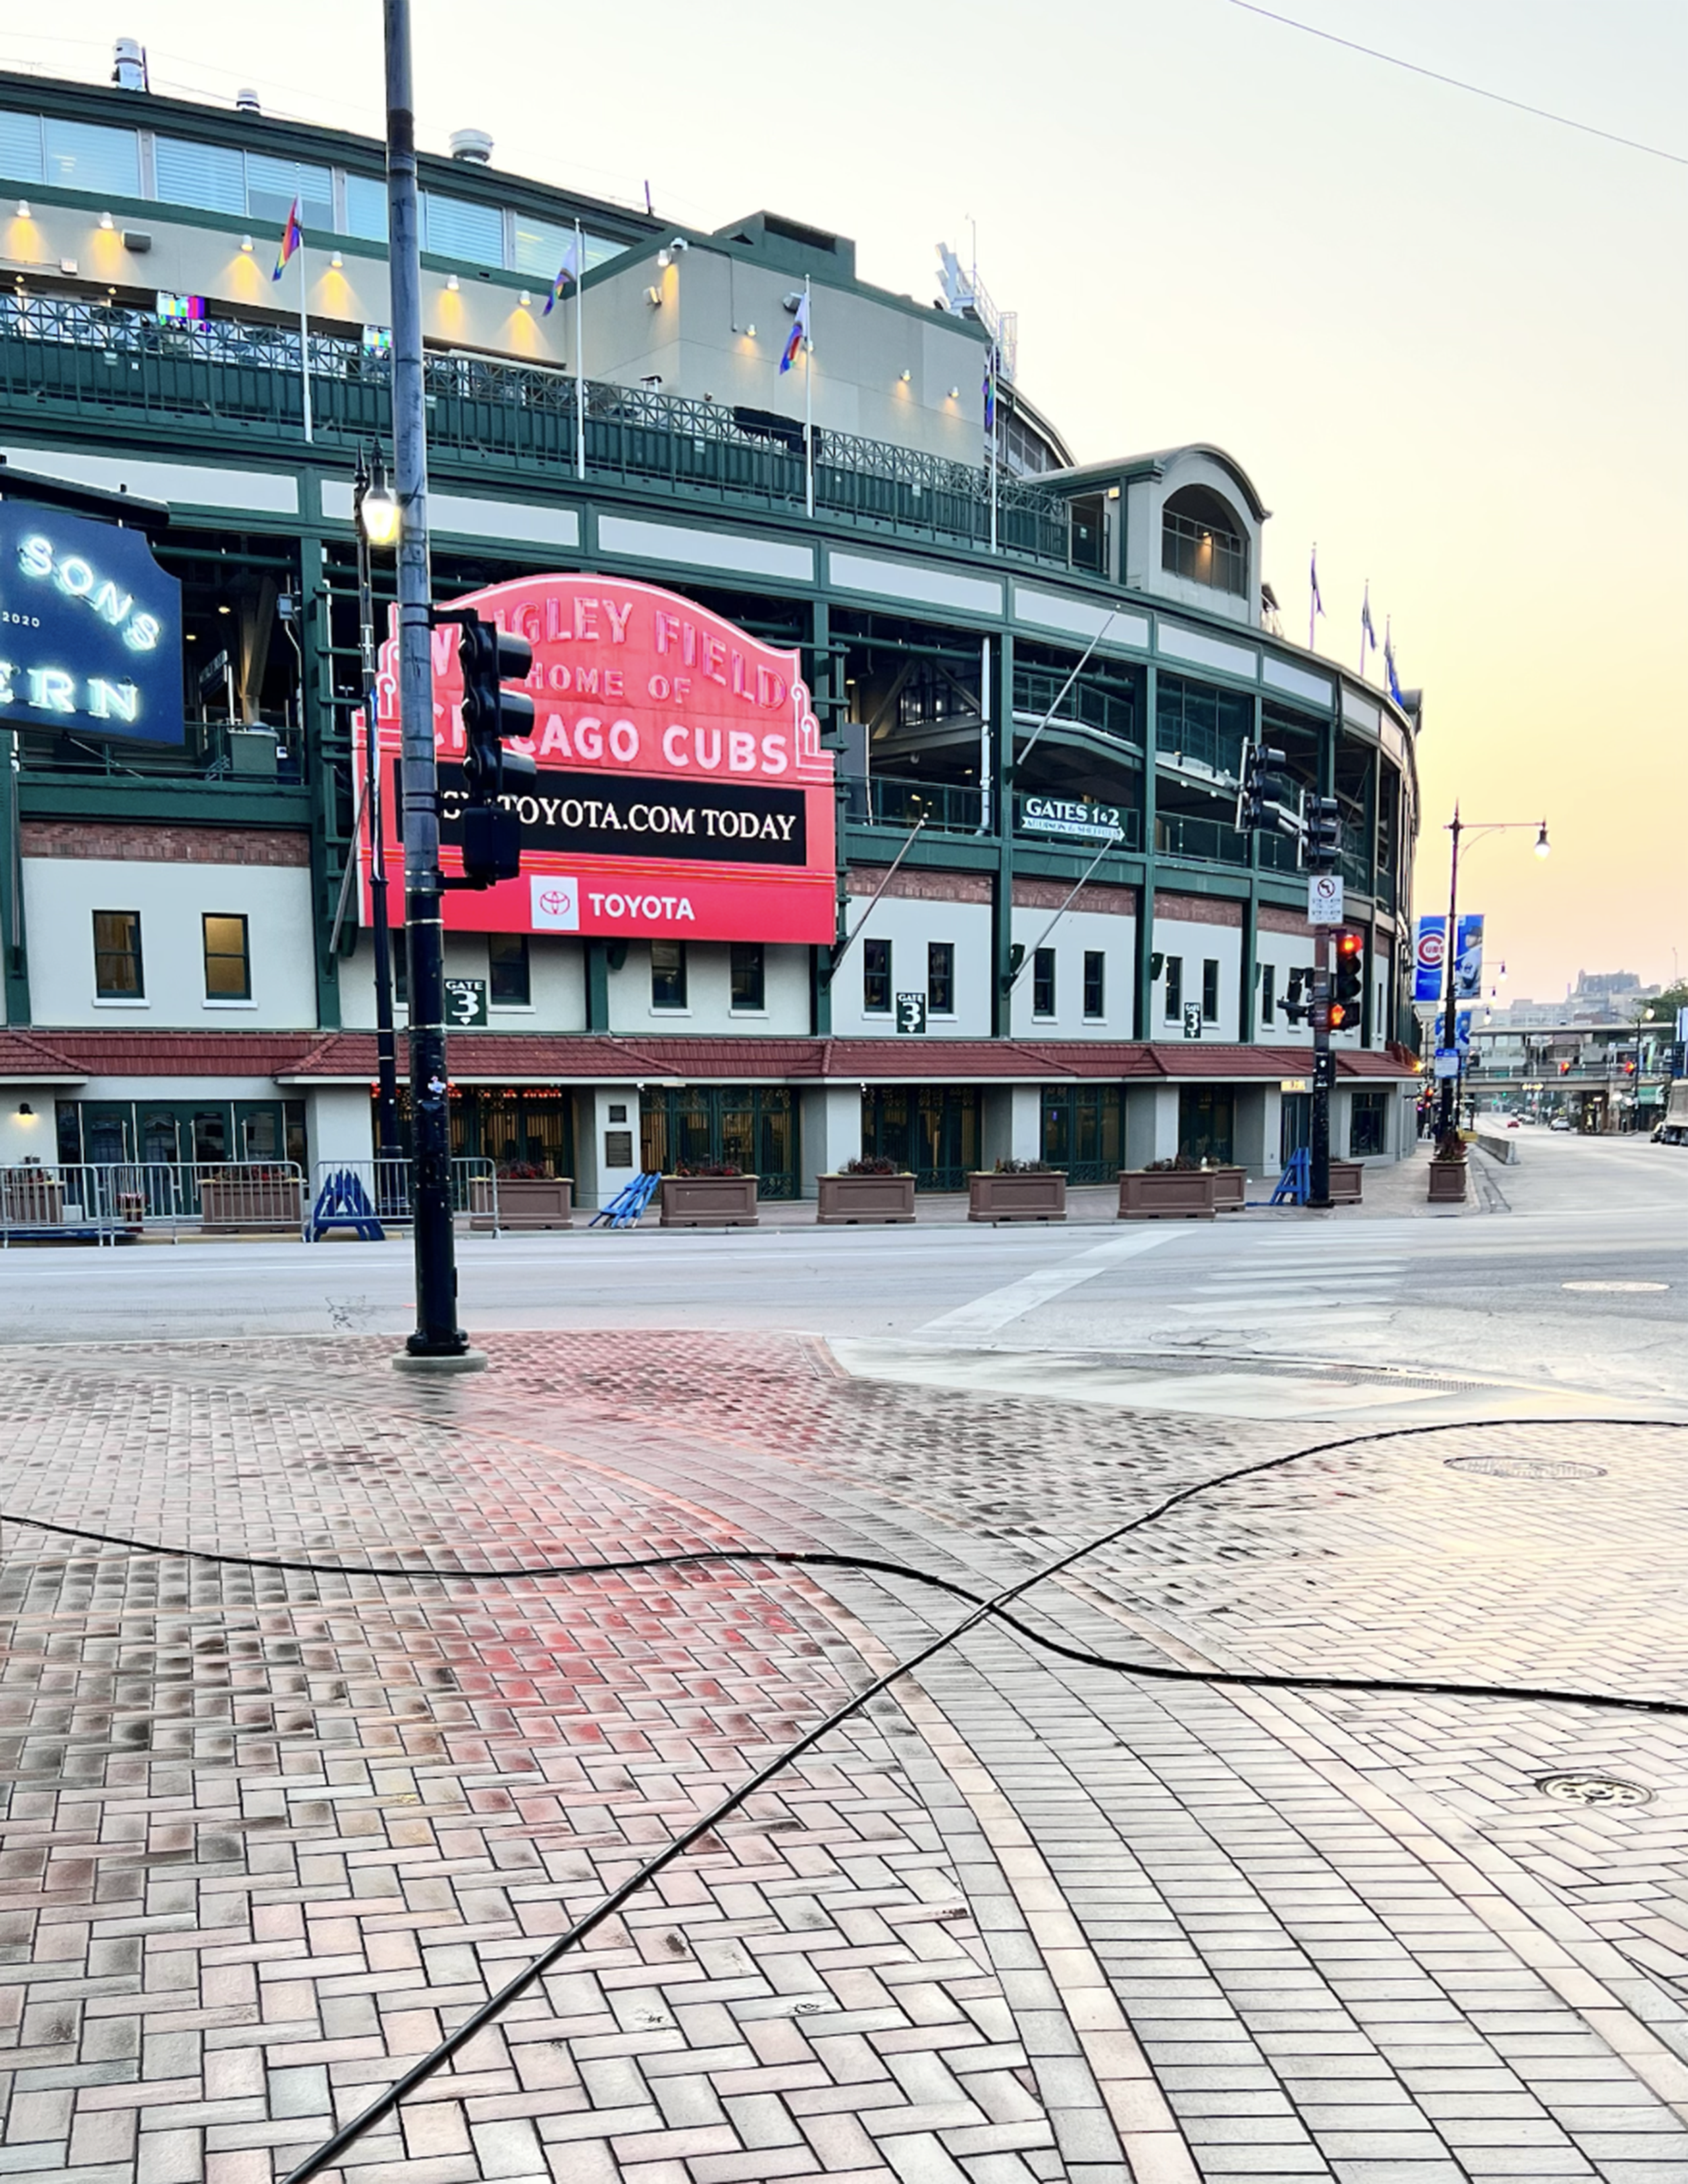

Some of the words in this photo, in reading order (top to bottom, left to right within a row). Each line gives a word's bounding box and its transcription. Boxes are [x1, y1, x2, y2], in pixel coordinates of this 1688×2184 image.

[18, 536, 161, 651] SONS
[3, 611, 40, 628] 2020
[656, 610, 787, 711] FIELD
[524, 662, 625, 696] HOME
[648, 674, 691, 703] OF
[662, 724, 788, 774] CUBS
[1026, 798, 1088, 822] GATES
[701, 809, 796, 841] TODAY
[588, 893, 695, 921] TOYOTA
[446, 980, 483, 990] GATE
[451, 990, 479, 1016] 3
[898, 994, 924, 1003] GATE
[901, 1003, 921, 1026] 3
[1187, 1011, 1198, 1031] 3
